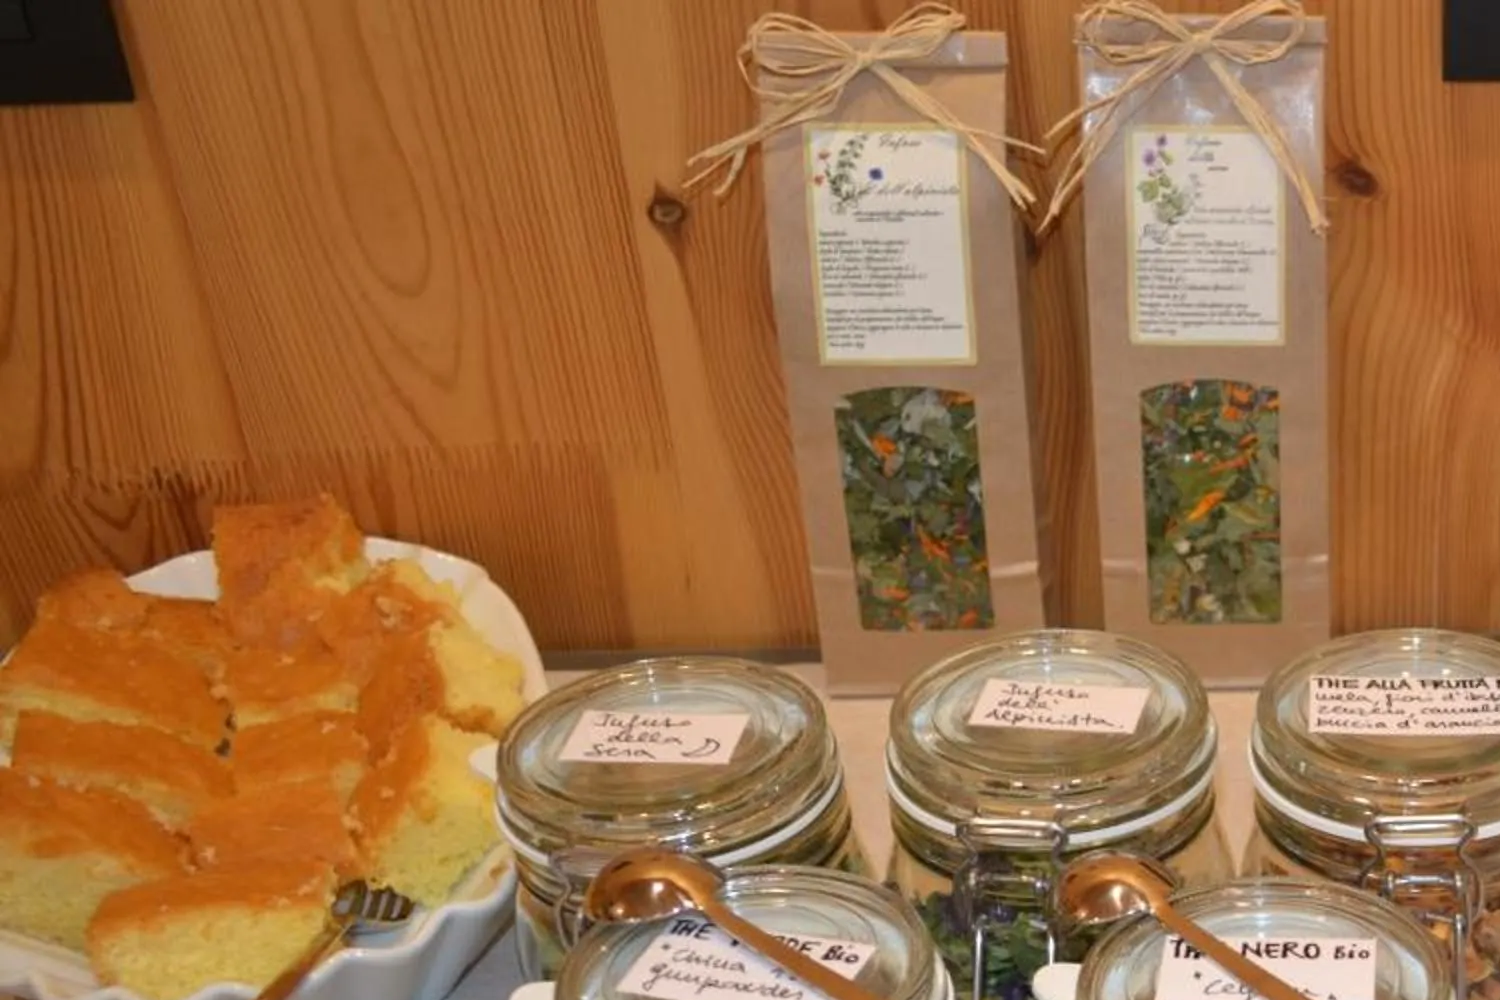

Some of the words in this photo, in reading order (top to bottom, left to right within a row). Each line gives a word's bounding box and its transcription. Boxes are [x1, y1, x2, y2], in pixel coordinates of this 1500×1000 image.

[1366, 678, 1412, 691] ALLA
[594, 713, 692, 732] Infuso
[607, 730, 683, 746] della
[670, 918, 717, 941] THE
[1170, 938, 1207, 960] TH
[1240, 941, 1322, 960] NERO
